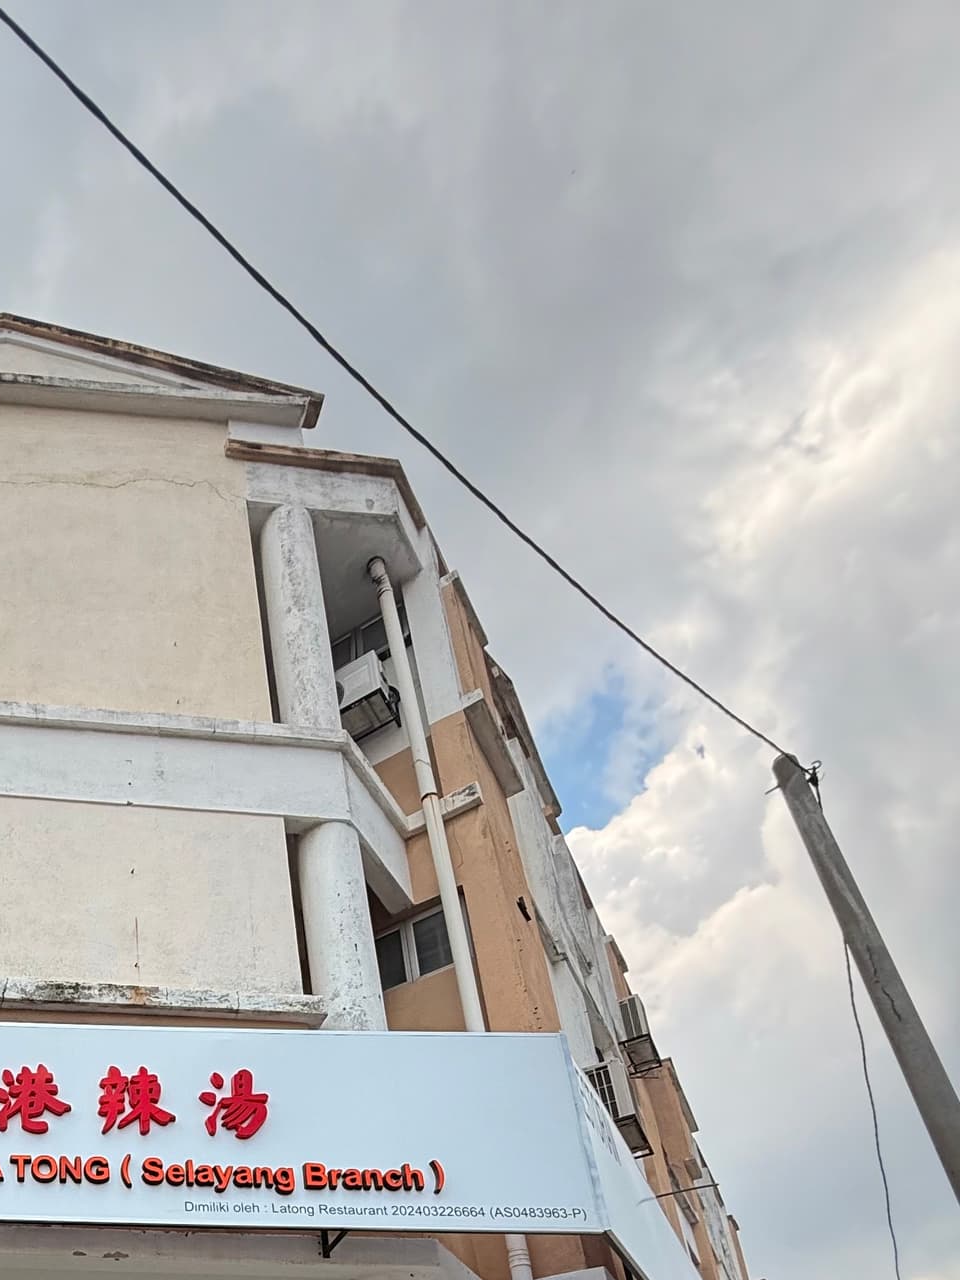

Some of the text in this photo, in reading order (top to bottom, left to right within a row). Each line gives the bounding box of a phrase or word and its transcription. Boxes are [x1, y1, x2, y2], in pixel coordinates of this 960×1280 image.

[9, 1154, 111, 1185] TONG
[141, 1156, 296, 1195] Selayang
[303, 1161, 425, 1192] Branch
[184, 1201, 229, 1213] Dimiliki
[233, 1202, 260, 1214] oleh
[271, 1203, 315, 1217] Latong
[318, 1204, 388, 1216] Restaurant
[391, 1205, 486, 1218] 202403226664
[489, 1206, 588, 1221] (AS0483963-P)
